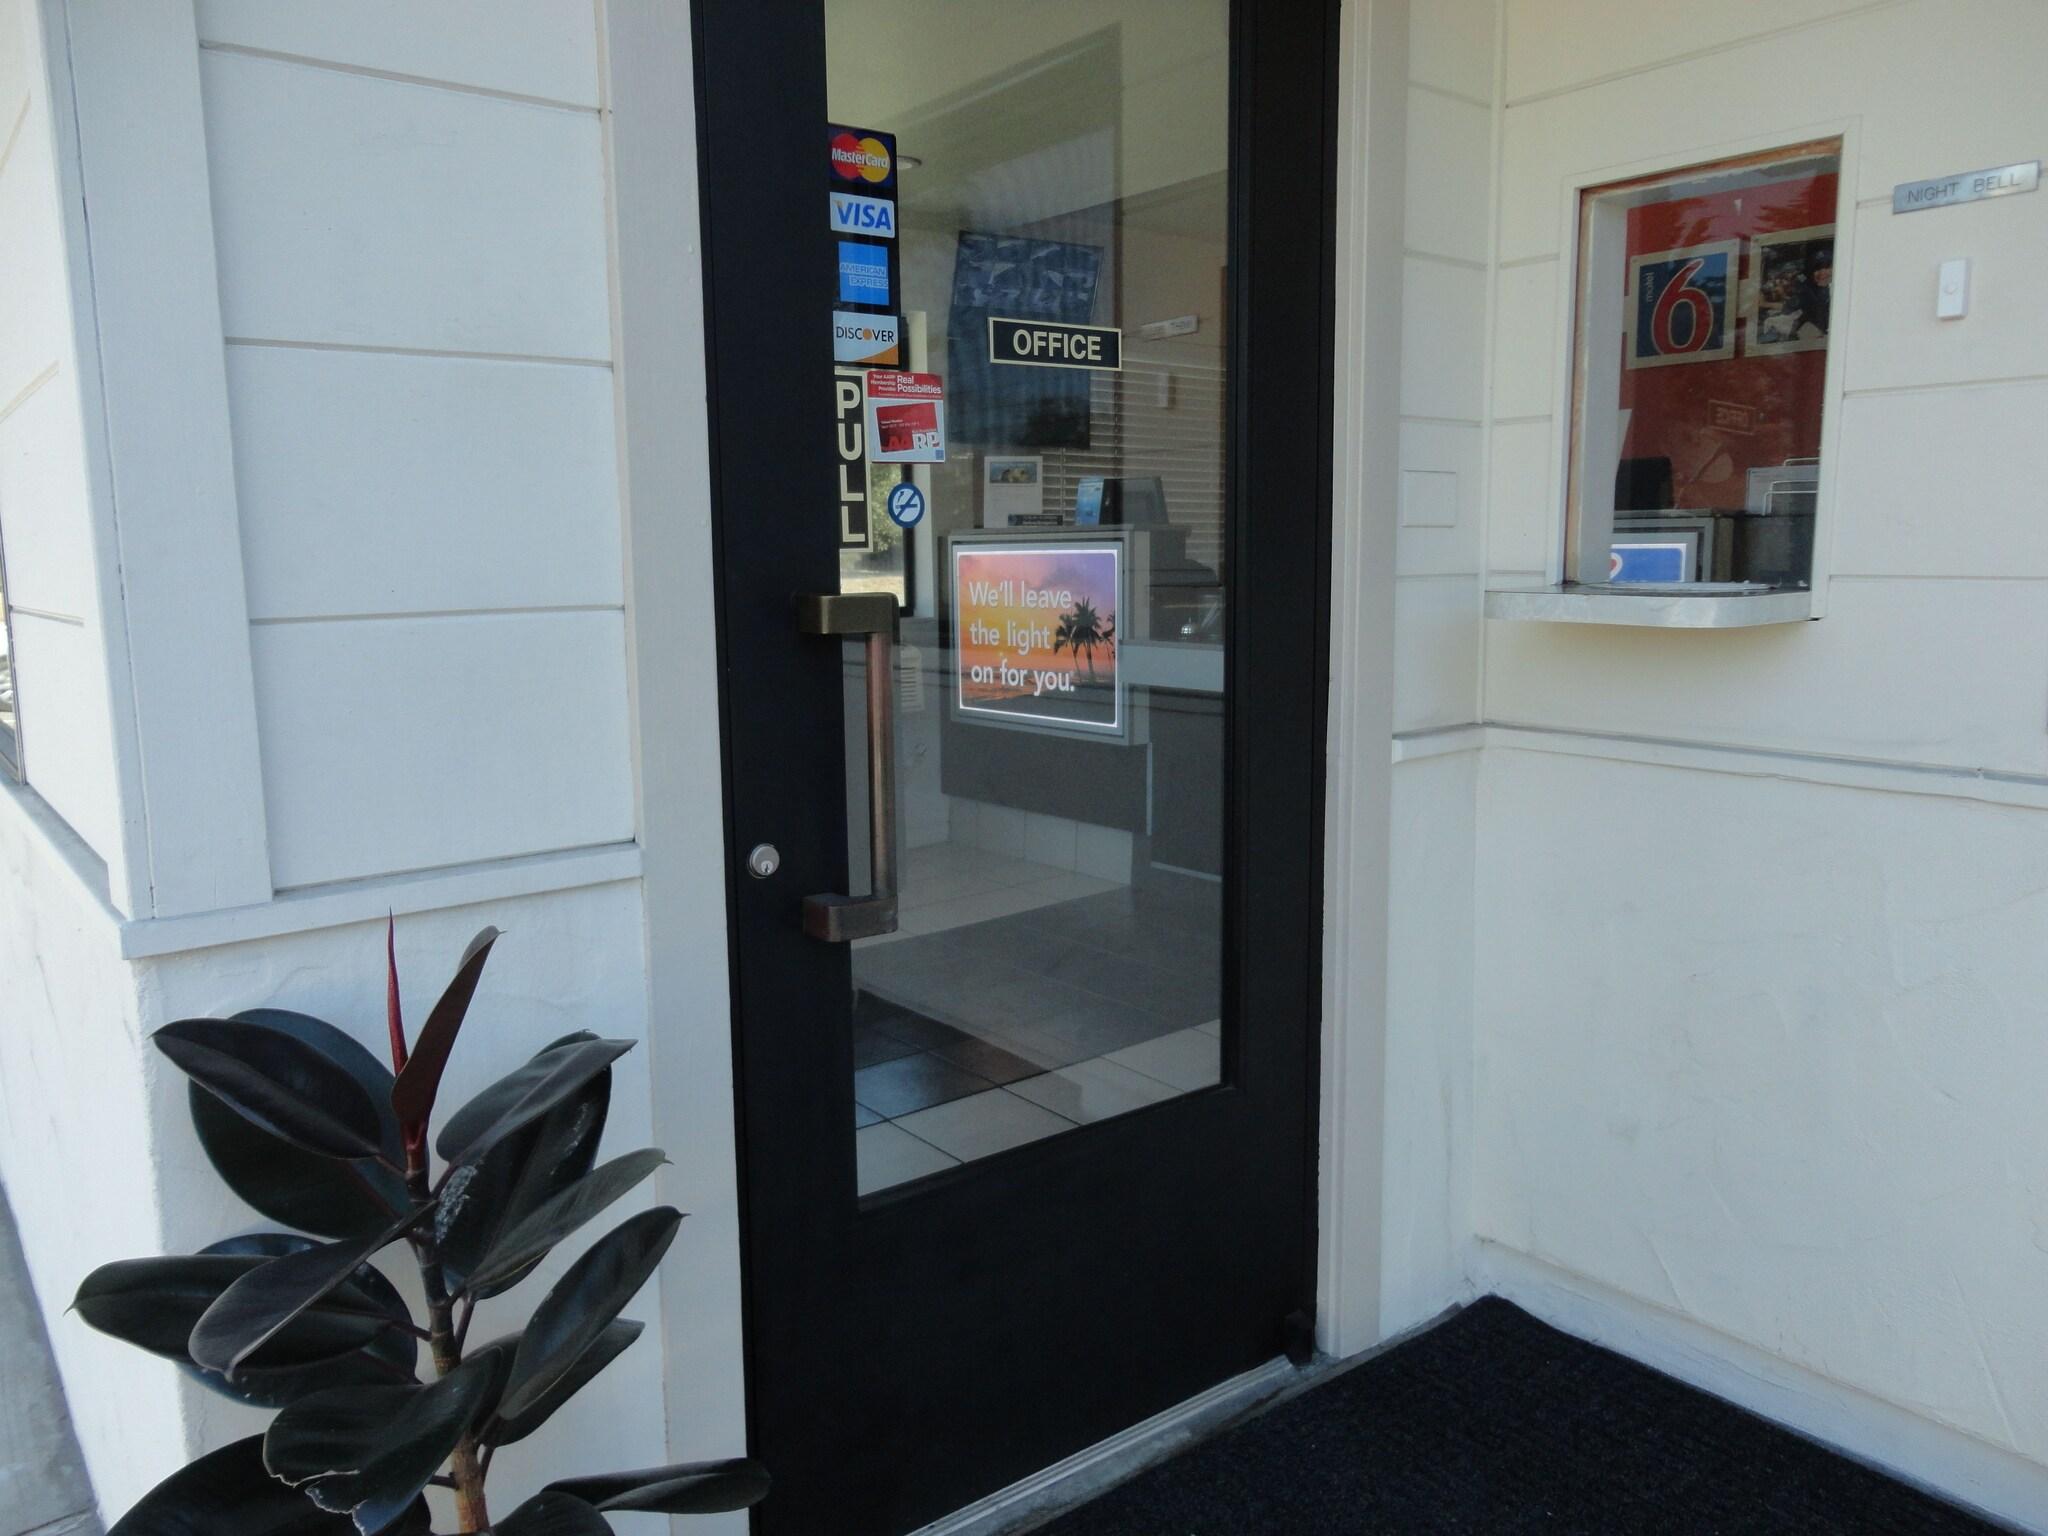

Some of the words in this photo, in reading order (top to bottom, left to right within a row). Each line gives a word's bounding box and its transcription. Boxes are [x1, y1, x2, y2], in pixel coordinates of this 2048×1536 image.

[831, 148, 888, 169] MasterCard
[1907, 182, 1960, 203] NIGHT
[1973, 173, 2022, 193] BELL
[836, 202, 891, 230] VISA
[840, 262, 887, 276] AMERICAN
[849, 276, 889, 289] EXPRESS
[1652, 258, 1714, 355] 6
[835, 326, 895, 343] DISCOVER
[1013, 328, 1102, 361] OFFICE
[896, 375, 915, 384] Real
[897, 384, 942, 394] Possibilities
[836, 381, 866, 542] PULL
[969, 581, 1014, 607] We'll
[1020, 581, 1072, 609] leave
[969, 618, 1000, 645] the
[1007, 620, 1051, 656] light
[971, 664, 994, 684] on
[1000, 658, 1028, 687] for
[1033, 670, 1075, 697] you.
